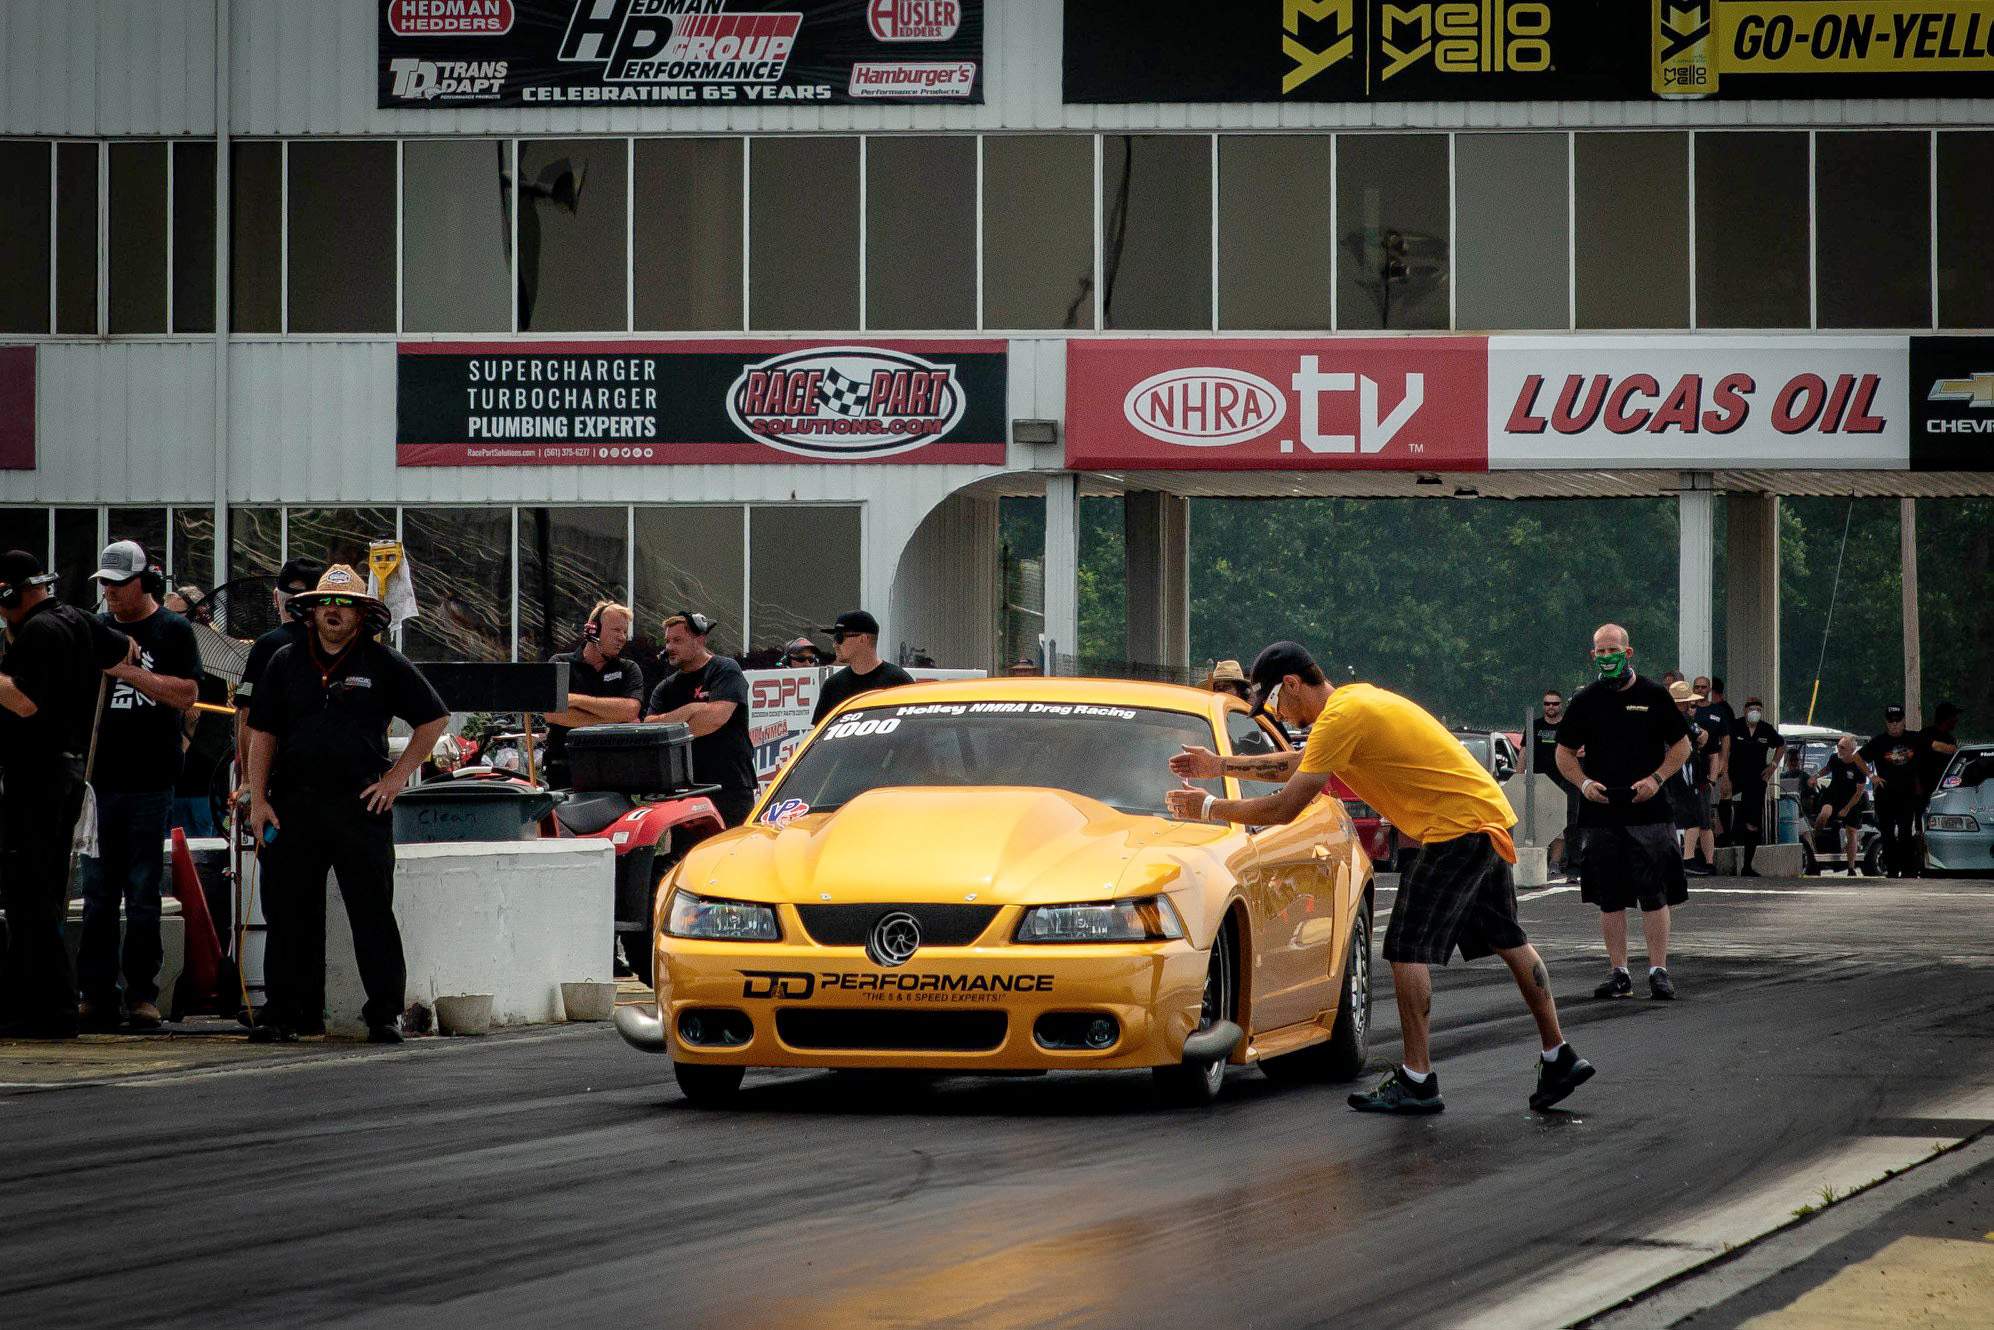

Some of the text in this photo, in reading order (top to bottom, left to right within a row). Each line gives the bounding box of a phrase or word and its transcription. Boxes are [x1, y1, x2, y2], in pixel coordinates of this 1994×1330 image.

[401, 0, 500, 16] HEDMAN
[401, 18, 501, 30] HEDDERS
[668, 36, 789, 61] GROUP
[1733, 13, 1994, 61] GO-ON-YELL
[436, 61, 509, 79] TRANS
[855, 64, 971, 87] Hamburger's
[440, 79, 506, 94] DAPT
[522, 84, 832, 101] CELEBRATING 65 YEARS
[860, 88, 960, 96] Performance Products
[468, 359, 656, 382] SUPERCHARGER
[467, 387, 657, 410] TURBOCHARGER
[743, 369, 949, 417] RACE PART
[1150, 381, 1263, 432] NHRA
[1280, 355, 1424, 453] .tv
[1504, 372, 1888, 435] LUCAS OIL
[468, 415, 657, 438] PLUMBING EXPERTS
[751, 418, 944, 436] SOLUTIONS.COM
[896, 703, 1137, 720] Holley NMRA Drag Racing
[823, 718, 901, 741] 1000
[768, 799, 801, 822] VP
[820, 972, 1055, 992] PERFORMANCE
[914, 993, 949, 1002] SPEED
